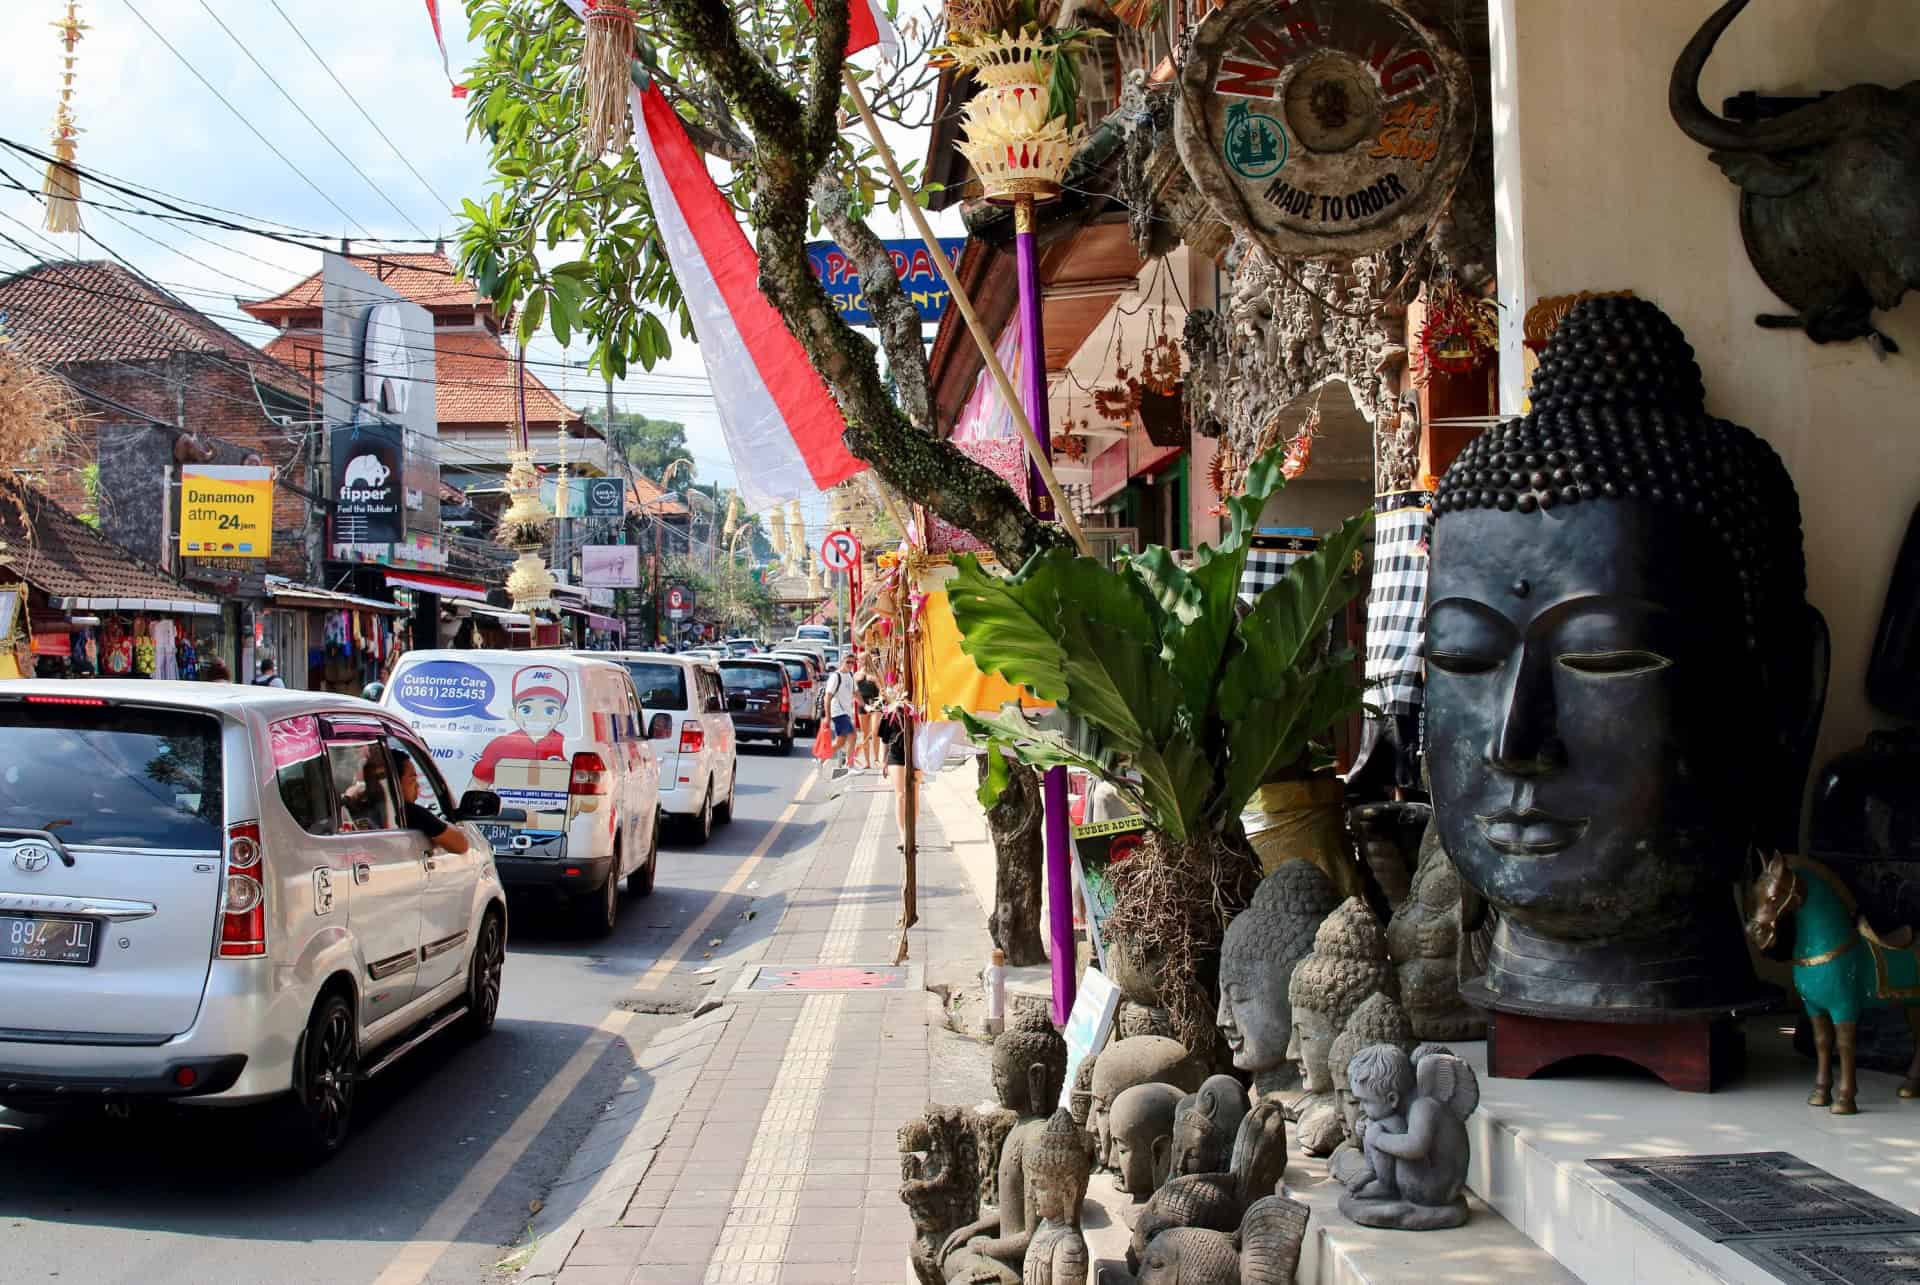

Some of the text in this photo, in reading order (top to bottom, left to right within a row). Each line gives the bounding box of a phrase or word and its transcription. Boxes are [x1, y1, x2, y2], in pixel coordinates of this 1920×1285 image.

[1263, 173, 1408, 222] MADE TO ORDER
[188, 490, 255, 504] Danamon
[340, 486, 386, 503] fipper
[367, 504, 393, 513] Rubber
[188, 508, 217, 521] atm
[218, 514, 240, 530] 24
[403, 674, 488, 688] Customer Care
[400, 685, 486, 700] (0361) 285453
[429, 748, 454, 759] IND
[11, 920, 89, 948] 894 JL
